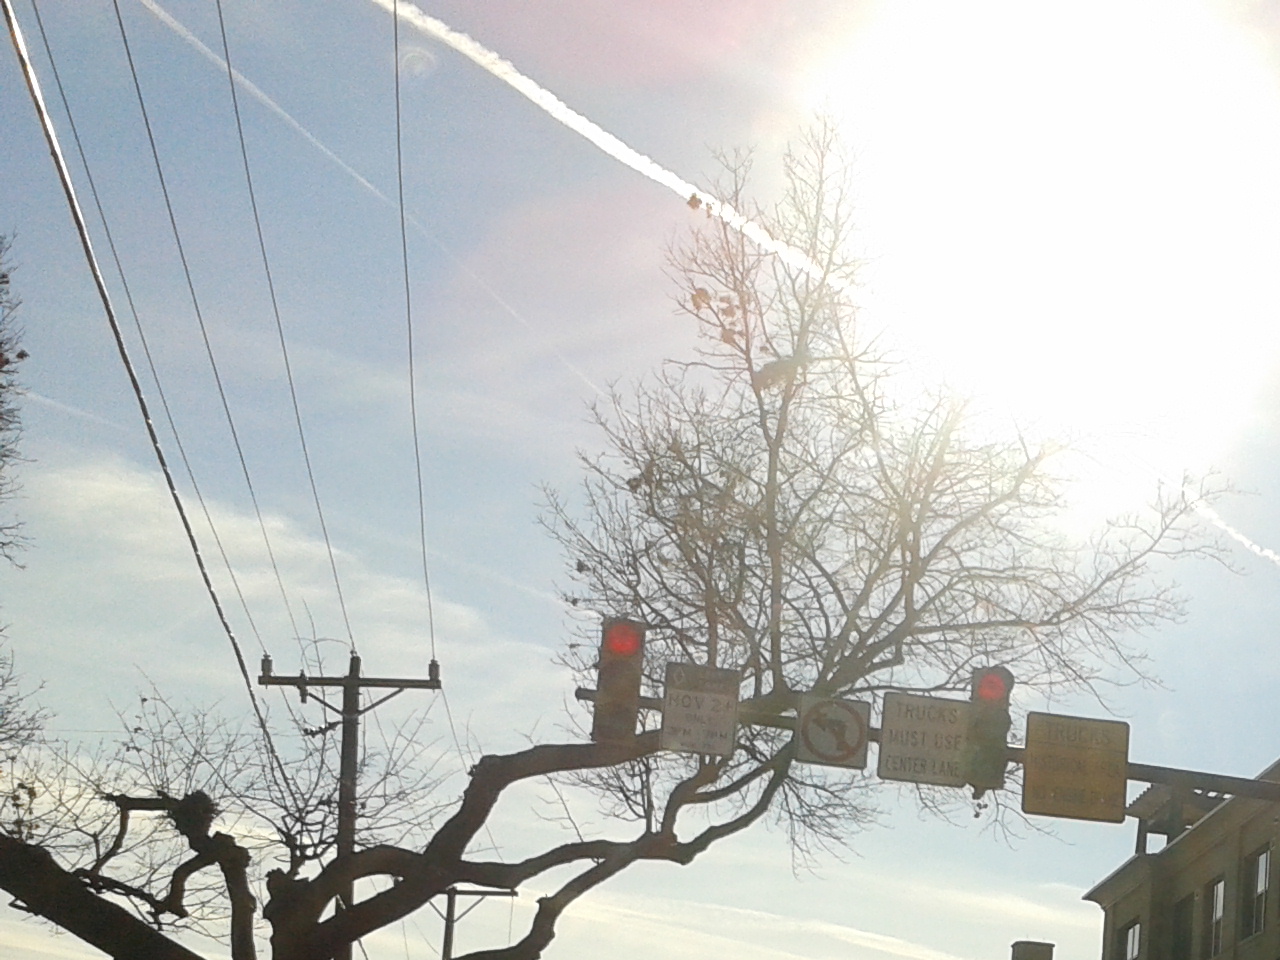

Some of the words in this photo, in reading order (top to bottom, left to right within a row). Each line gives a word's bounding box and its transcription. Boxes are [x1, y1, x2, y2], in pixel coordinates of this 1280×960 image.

[896, 701, 957, 724] TRUCKS
[889, 729, 927, 748] MUST
[934, 732, 962, 750] USE
[1046, 722, 1112, 746] TRUCKS
[885, 756, 928, 774] CENTER
[932, 760, 960, 778] LANE
